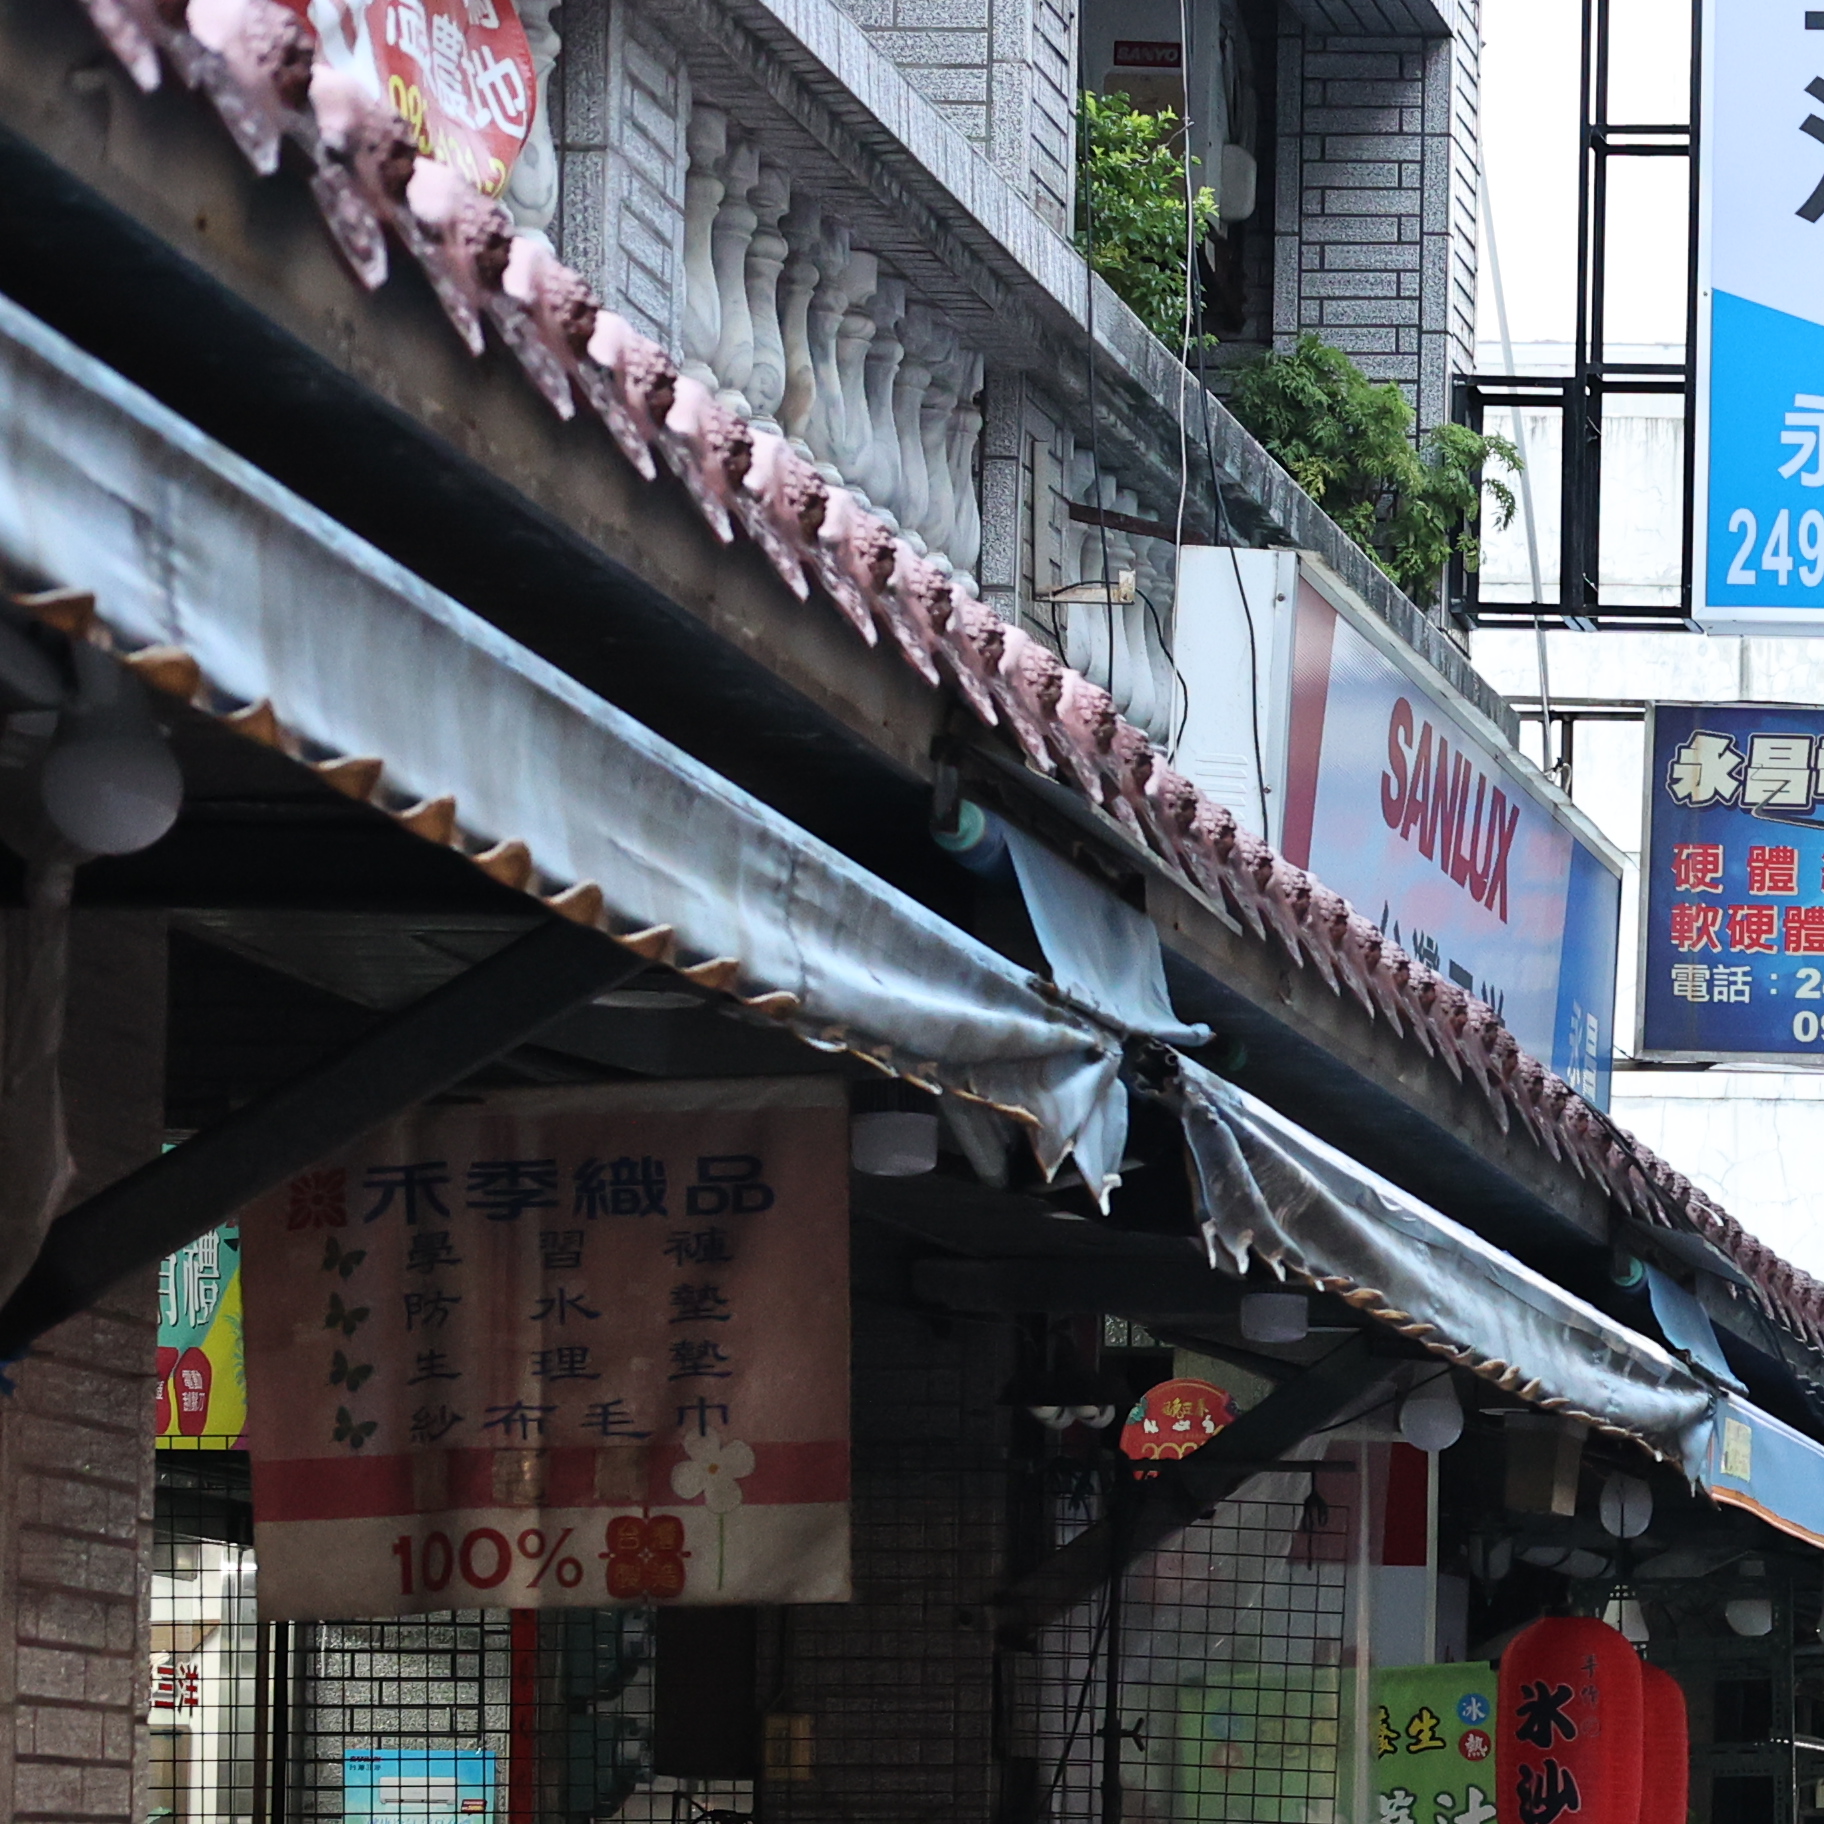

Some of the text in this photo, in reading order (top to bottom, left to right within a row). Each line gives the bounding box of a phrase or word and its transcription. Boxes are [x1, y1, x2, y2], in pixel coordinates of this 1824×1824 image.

[1381, 696, 1520, 925] SANLUX
[363, 1155, 774, 1222] 禾季織品
[407, 1230, 732, 1272] 學習褲
[405, 1283, 731, 1329] 防水墊
[408, 1339, 732, 1386] 生理墊
[410, 1397, 731, 1443] 紗布毛巾
[393, 1527, 584, 1596] 100%
